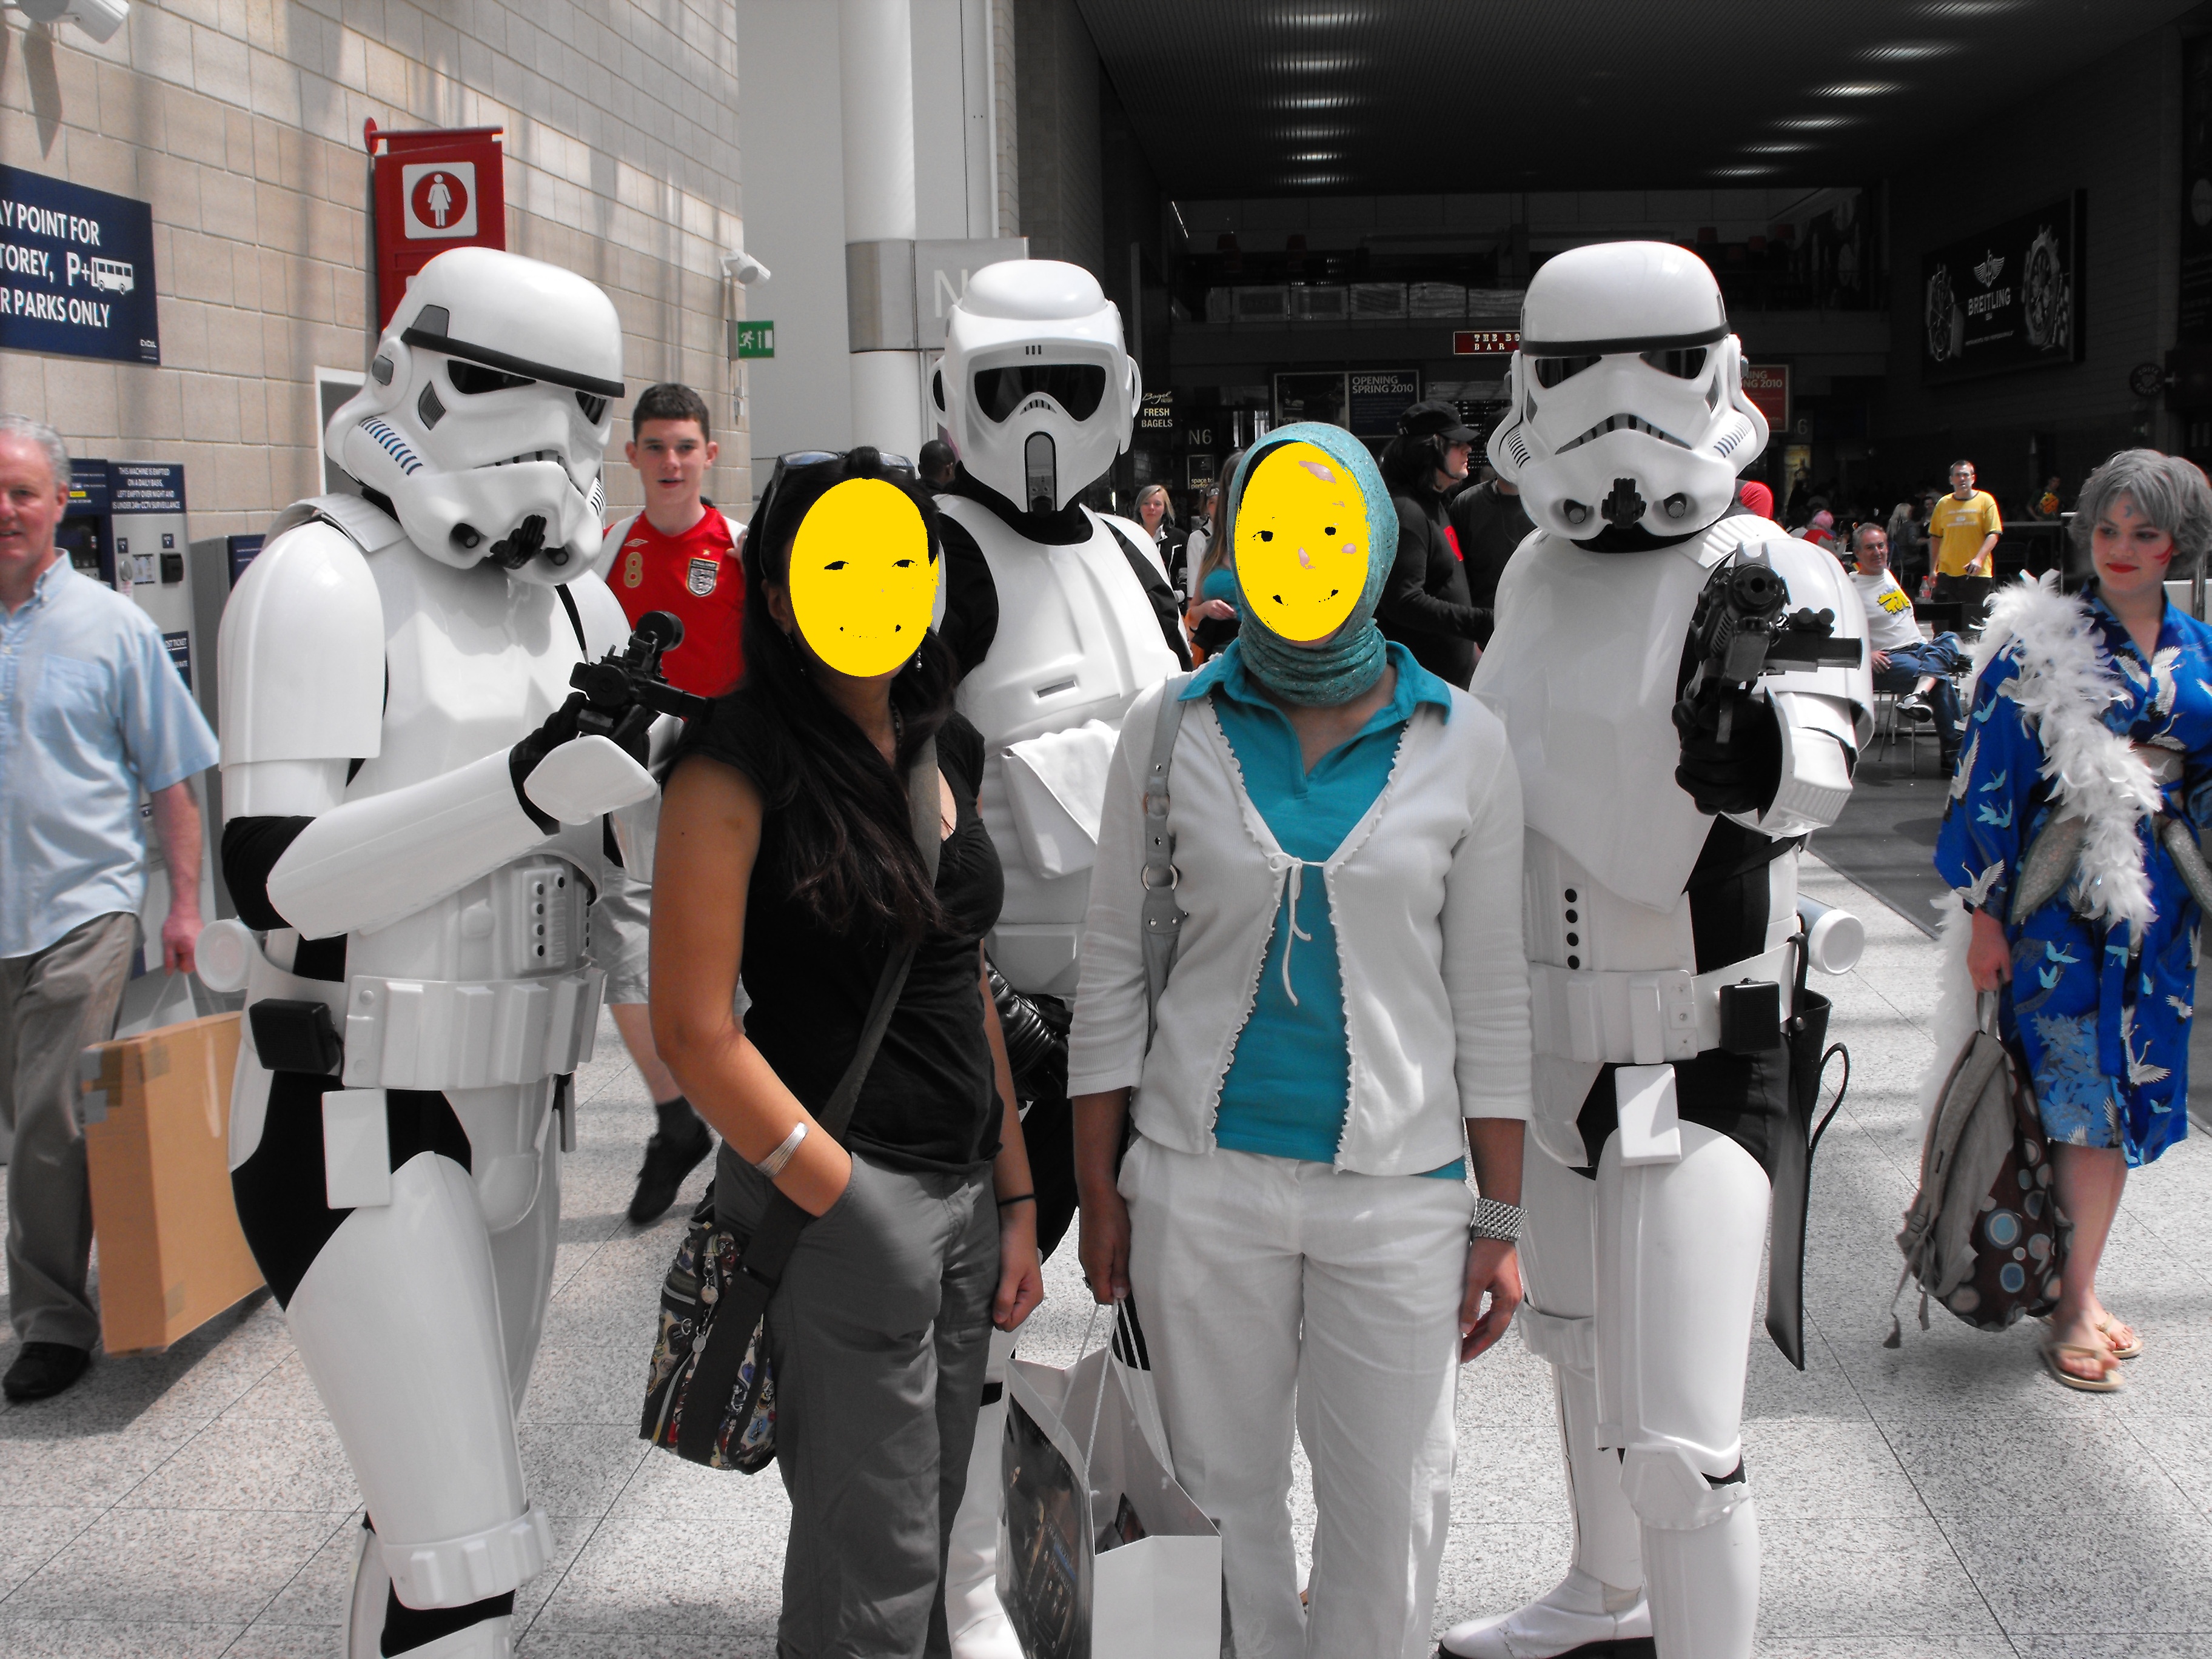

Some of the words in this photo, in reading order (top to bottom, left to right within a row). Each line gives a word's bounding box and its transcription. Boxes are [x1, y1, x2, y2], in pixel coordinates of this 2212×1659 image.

[18, 203, 67, 238] POINT
[70, 216, 100, 246] FOR
[1968, 287, 2011, 316] BREITLING
[14, 289, 66, 321] PARKS
[69, 298, 110, 328] ONLY
[1474, 333, 1498, 342] THE
[1352, 376, 1398, 385] OPENING
[1760, 379, 1783, 387] 2010
[1352, 385, 1389, 394] SPRING
[1391, 384, 1414, 393] 2010
[1144, 407, 1170, 417] FRESH
[1141, 418, 1173, 428] BAGELS
[1188, 429, 1212, 445] N6
[129, 468, 149, 476] MACHINE
[624, 552, 643, 588] 8
